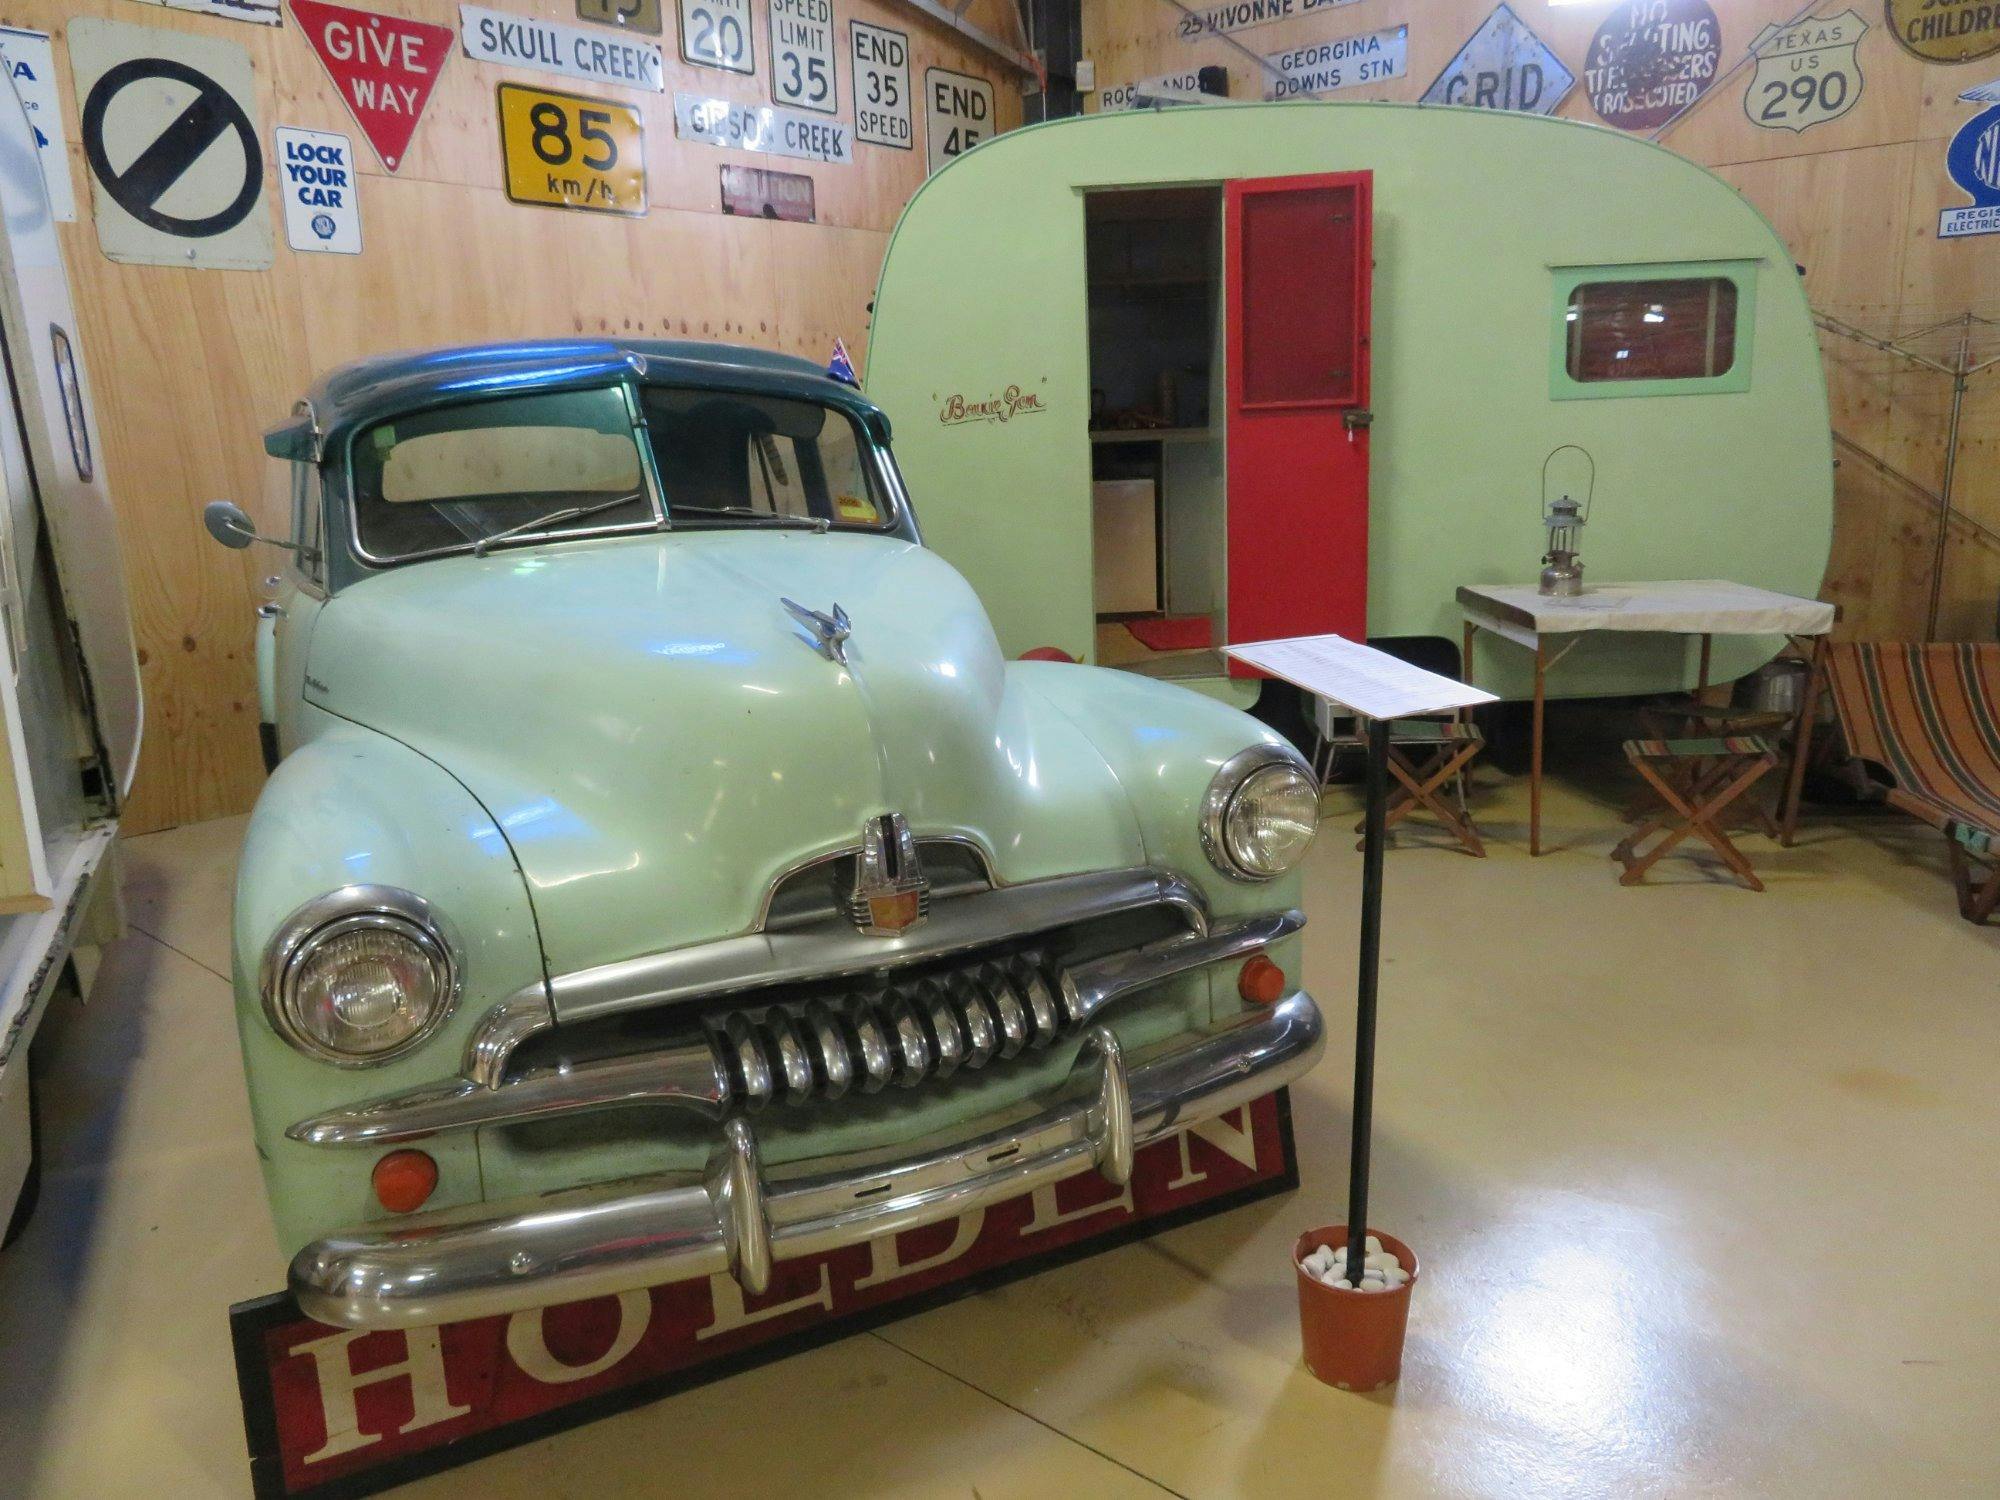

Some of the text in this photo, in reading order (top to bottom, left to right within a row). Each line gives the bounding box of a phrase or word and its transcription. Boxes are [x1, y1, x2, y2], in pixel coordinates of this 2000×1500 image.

[774, 0, 828, 23] SPEED
[1207, 0, 1294, 33] VIVONNE
[324, 21, 428, 74] GIVE
[480, 18, 652, 84] SKULL CREEK
[691, 7, 744, 62] 20
[780, 20, 825, 52] LIMIT
[855, 32, 904, 67] END
[1775, 26, 1842, 51] TEXAS
[1281, 36, 1381, 71] GEORGINA
[1791, 55, 1820, 72] US
[782, 51, 828, 102] 35
[867, 71, 899, 107] 35
[1275, 58, 1395, 98] DOWNS STN
[1446, 63, 1544, 111] GRID
[351, 77, 419, 116] WAY
[935, 82, 987, 121] END
[1761, 70, 1848, 120] 290
[530, 102, 618, 172] 85
[784, 120, 843, 158] CREEK
[860, 110, 908, 140] SPEED
[286, 142, 343, 166] LOCK
[286, 163, 348, 188] YOUR
[547, 173, 616, 203] km/h
[298, 186, 343, 209] CAR
